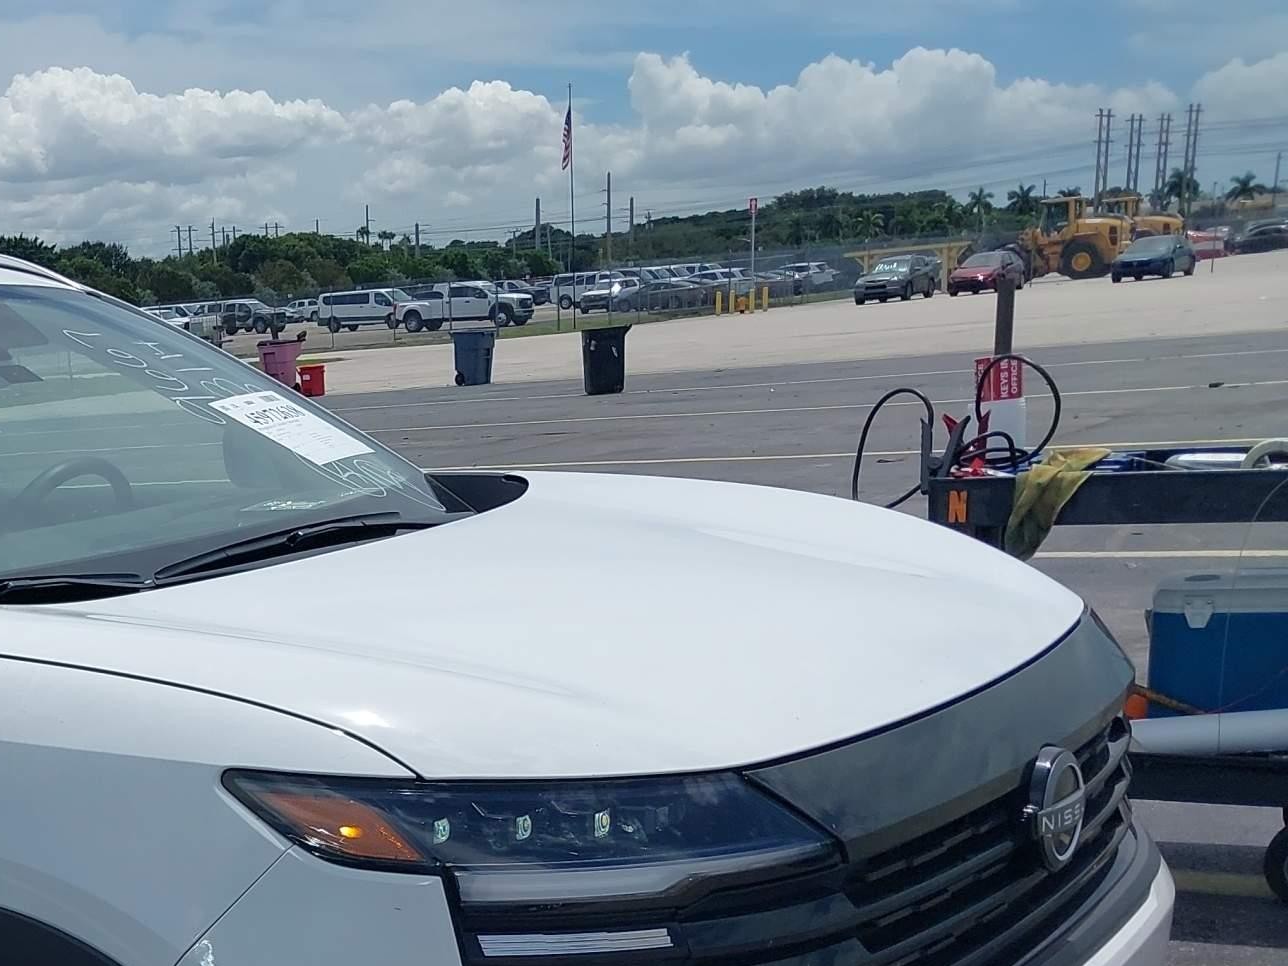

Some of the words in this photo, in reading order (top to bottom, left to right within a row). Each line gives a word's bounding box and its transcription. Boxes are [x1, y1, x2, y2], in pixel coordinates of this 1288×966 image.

[999, 371, 1009, 398] KEYS
[1010, 359, 1018, 394] OFFICE
[244, 403, 307, 426] 45972638
[948, 490, 968, 523] N
